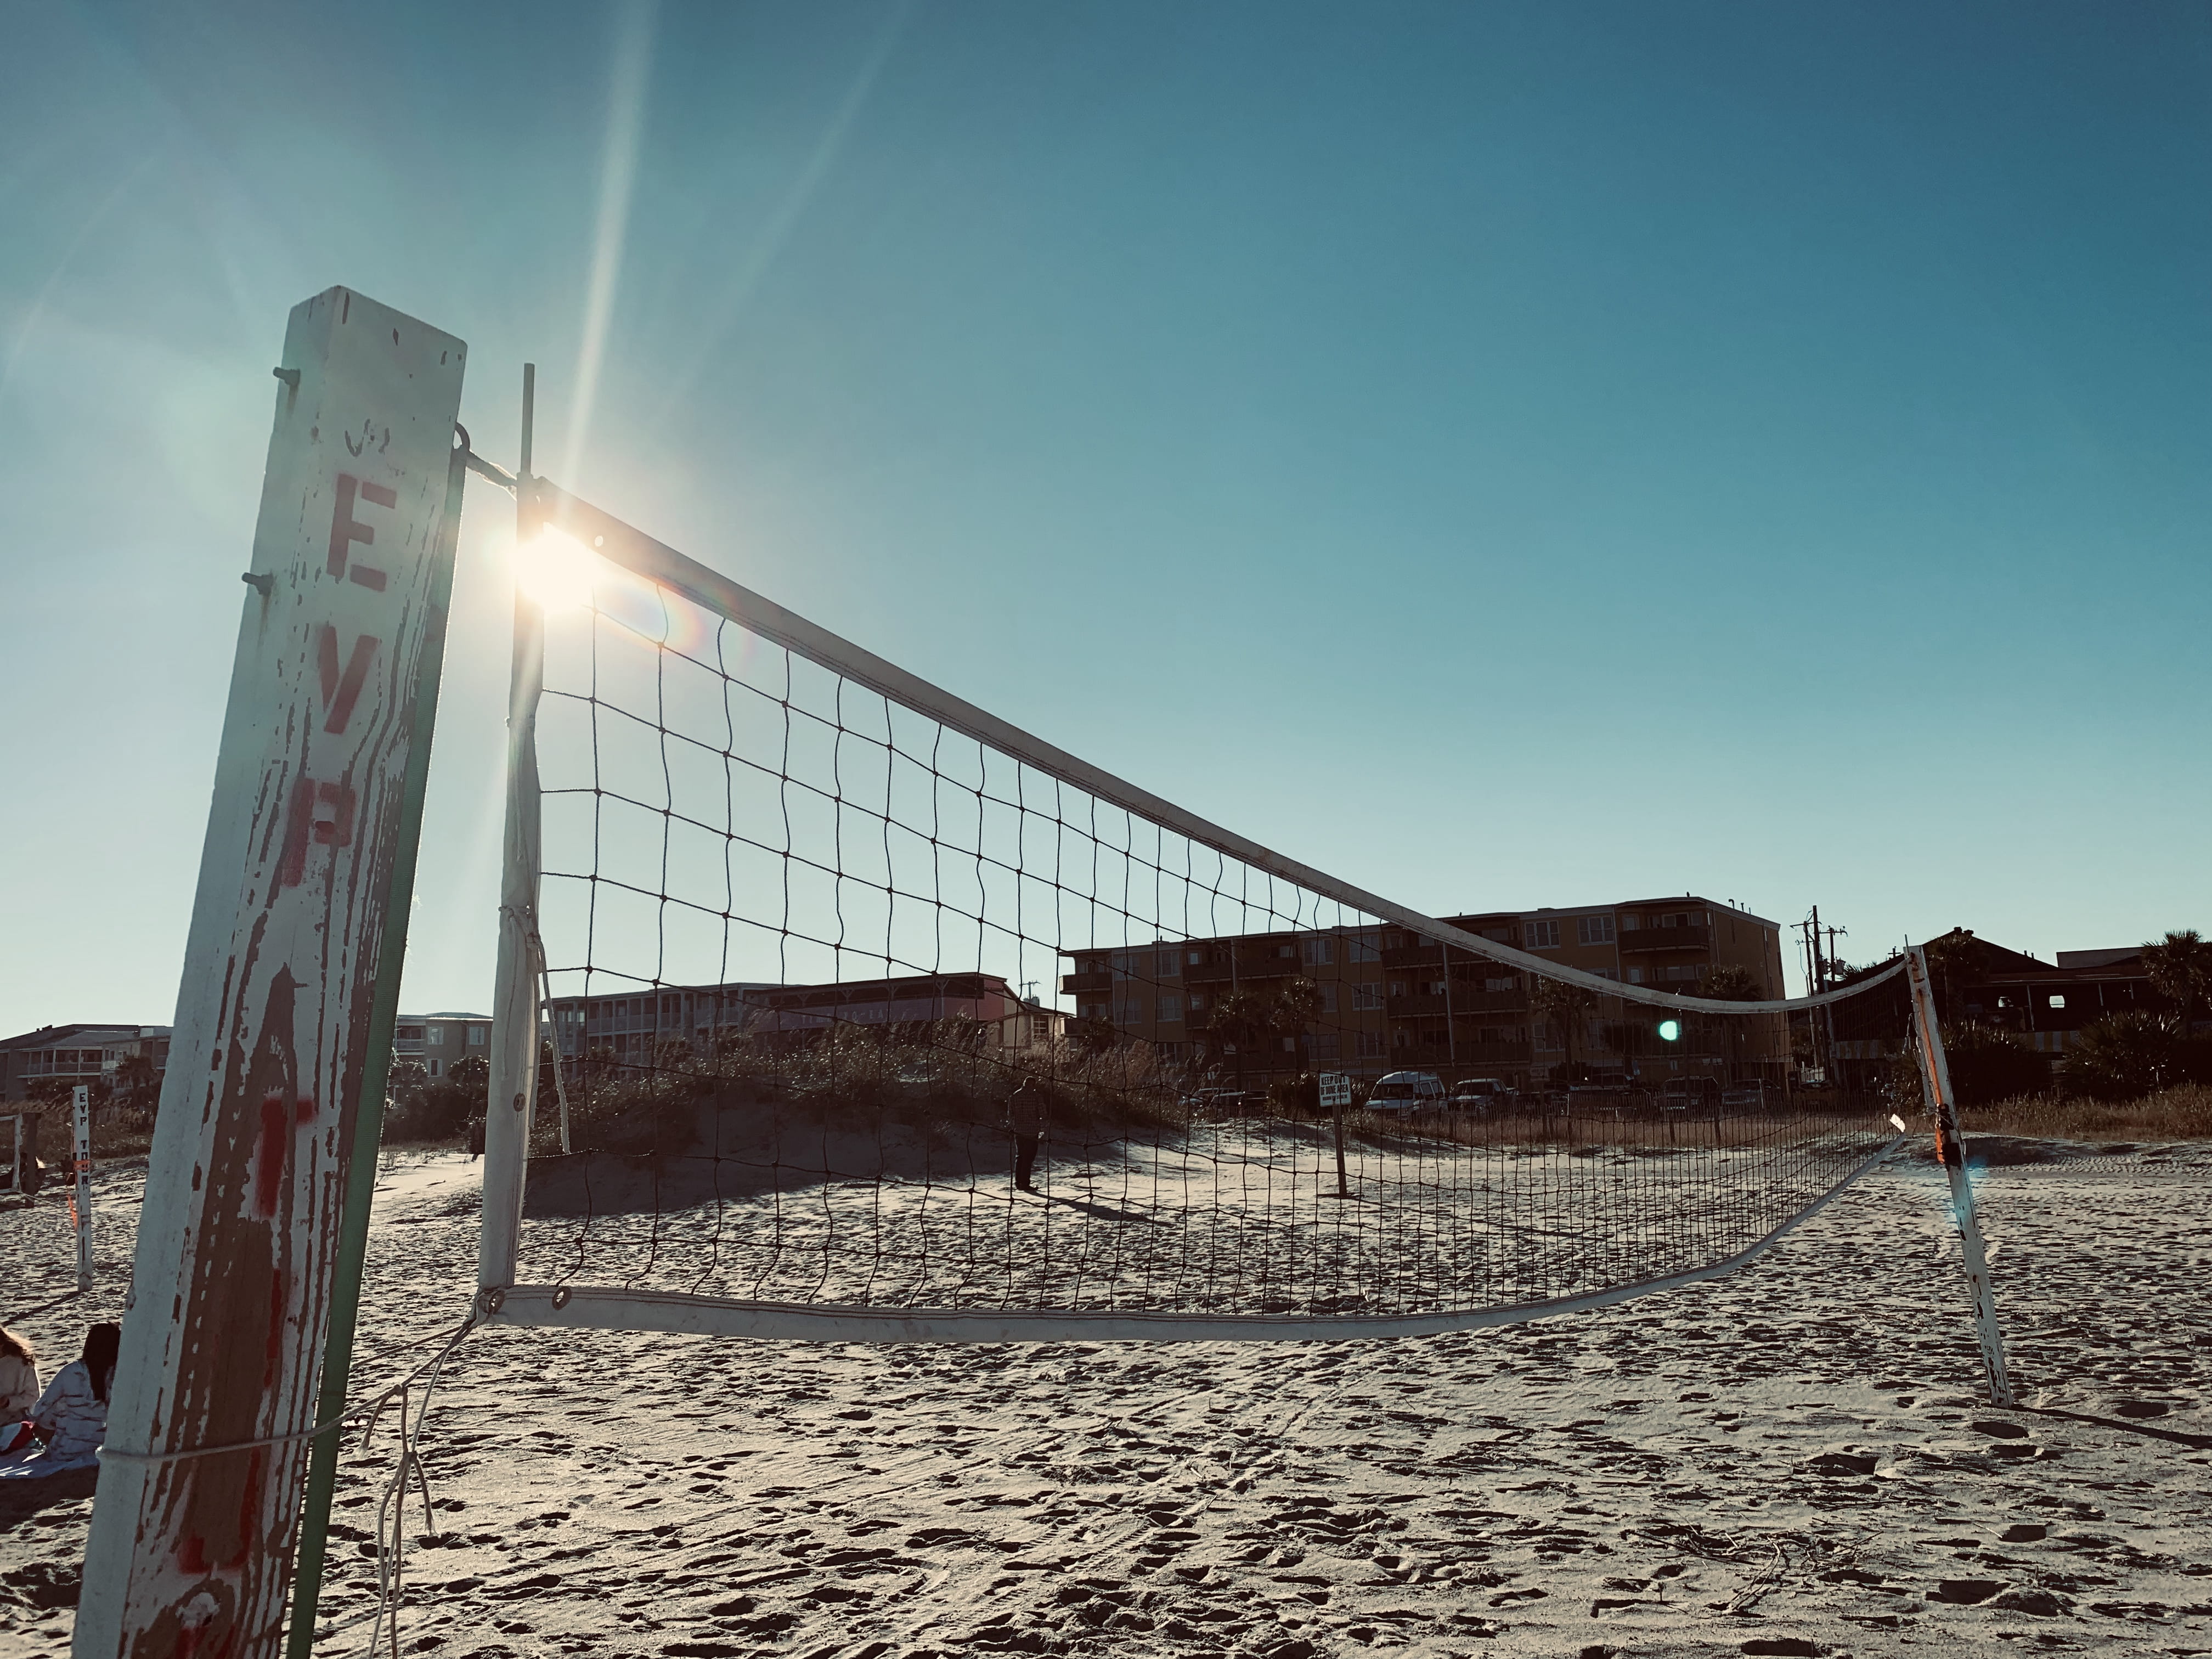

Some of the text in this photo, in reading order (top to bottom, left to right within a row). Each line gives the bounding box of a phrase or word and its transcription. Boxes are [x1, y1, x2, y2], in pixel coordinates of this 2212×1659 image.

[281, 473, 397, 888] EVP
[1321, 1075, 1345, 1085] KEEP OUT
[79, 1093, 87, 1126] EVP
